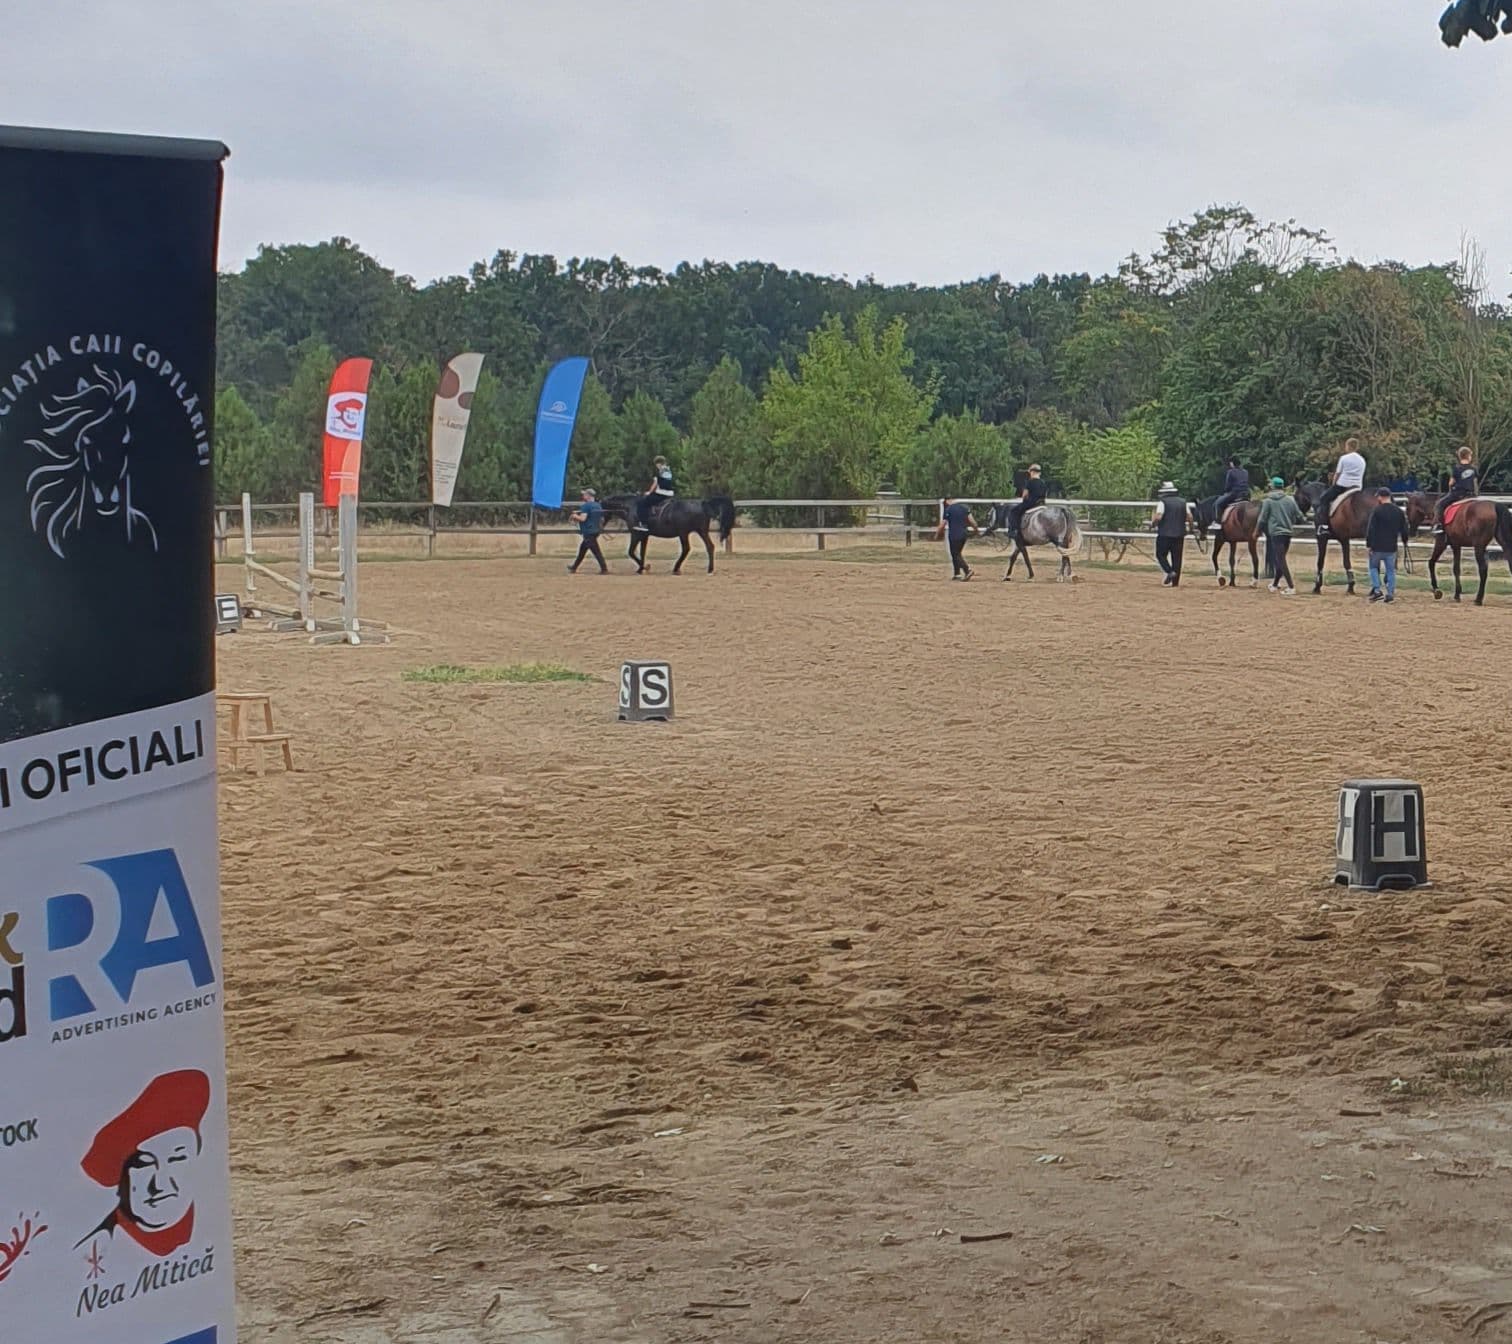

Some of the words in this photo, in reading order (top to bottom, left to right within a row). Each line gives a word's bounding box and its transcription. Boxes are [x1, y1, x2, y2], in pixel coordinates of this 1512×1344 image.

[69, 334, 121, 354] CAII
[132, 343, 210, 466] COPILĂRIEI
[217, 598, 239, 622] E
[641, 669, 667, 706] S
[21, 719, 205, 800] OFICIALI
[1374, 794, 1417, 857] H
[51, 1008, 158, 1044] ADVERTISING
[163, 992, 217, 1017] AGENCY
[0, 1117, 39, 1147] OCK
[76, 1283, 125, 1318] Nea
[131, 1245, 214, 1299] Mitică
